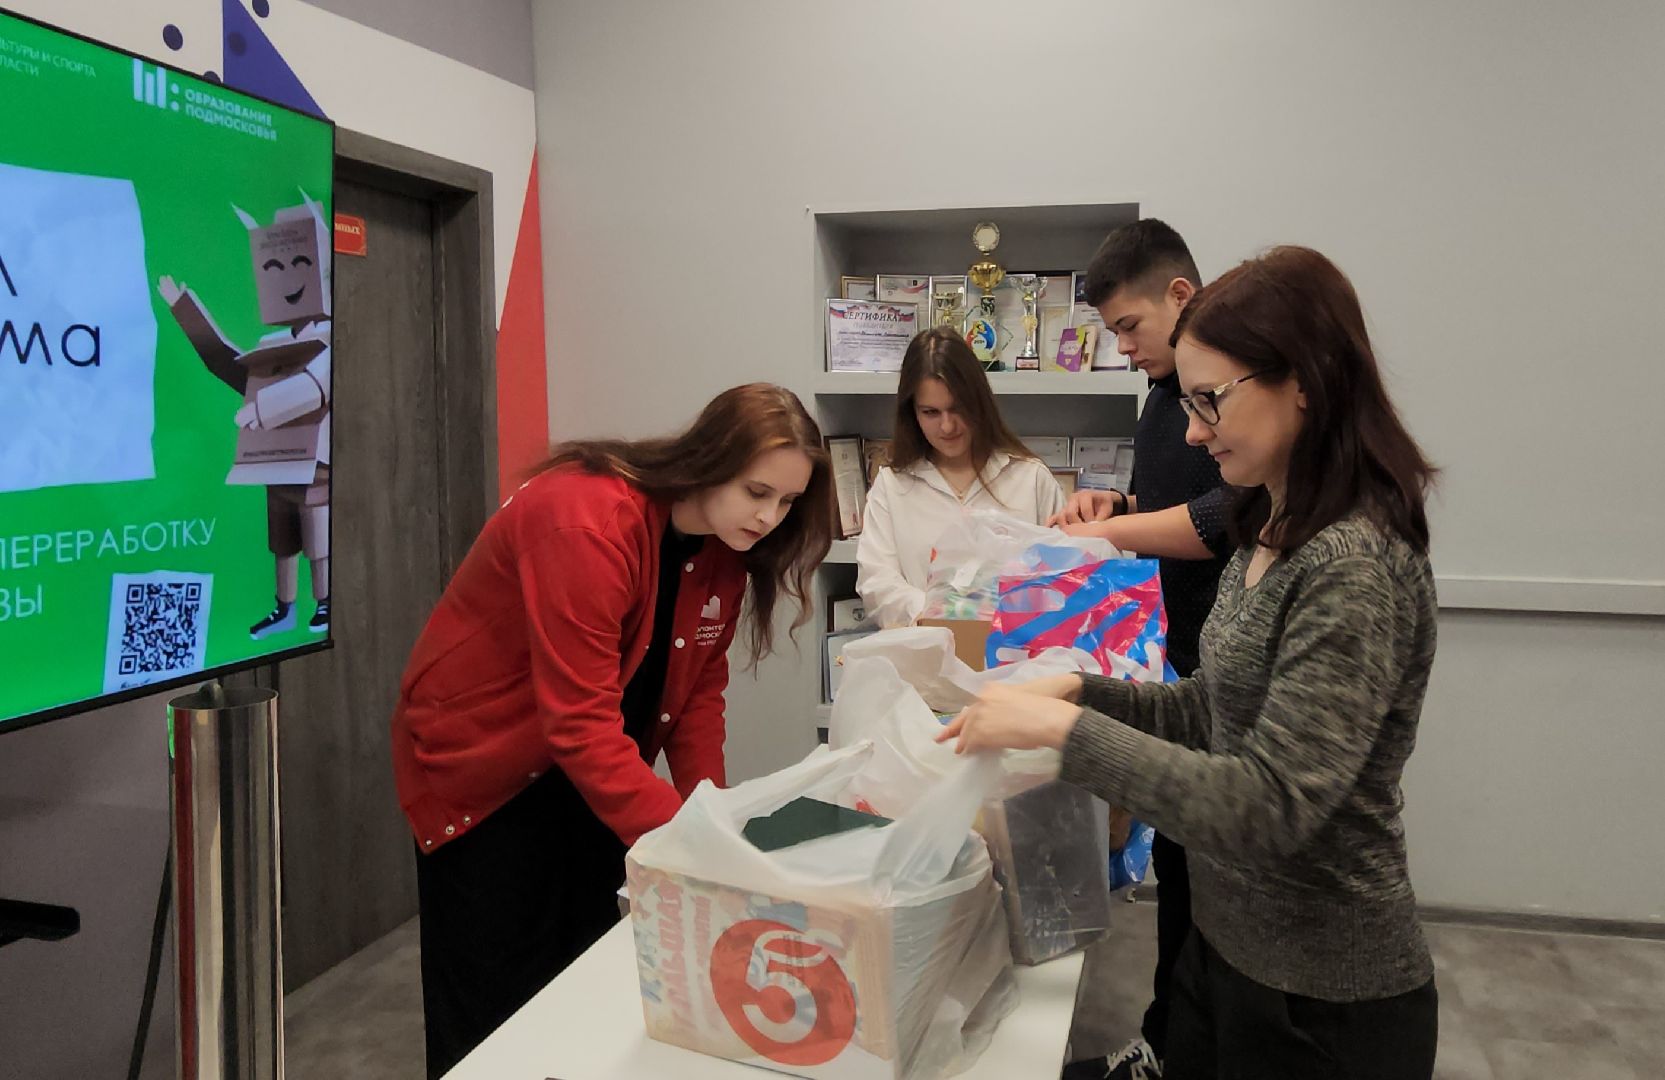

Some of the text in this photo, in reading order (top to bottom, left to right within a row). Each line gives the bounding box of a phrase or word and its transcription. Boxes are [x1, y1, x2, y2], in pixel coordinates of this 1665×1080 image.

[0, 38, 40, 60] ЬТУРЫ
[52, 55, 97, 78] СПОРТА
[185, 88, 272, 127] ОБРАЗОВАНИЕ
[185, 103, 277, 141] ПОДМОСКОВЬЯ
[741, 929, 847, 1044] 5
